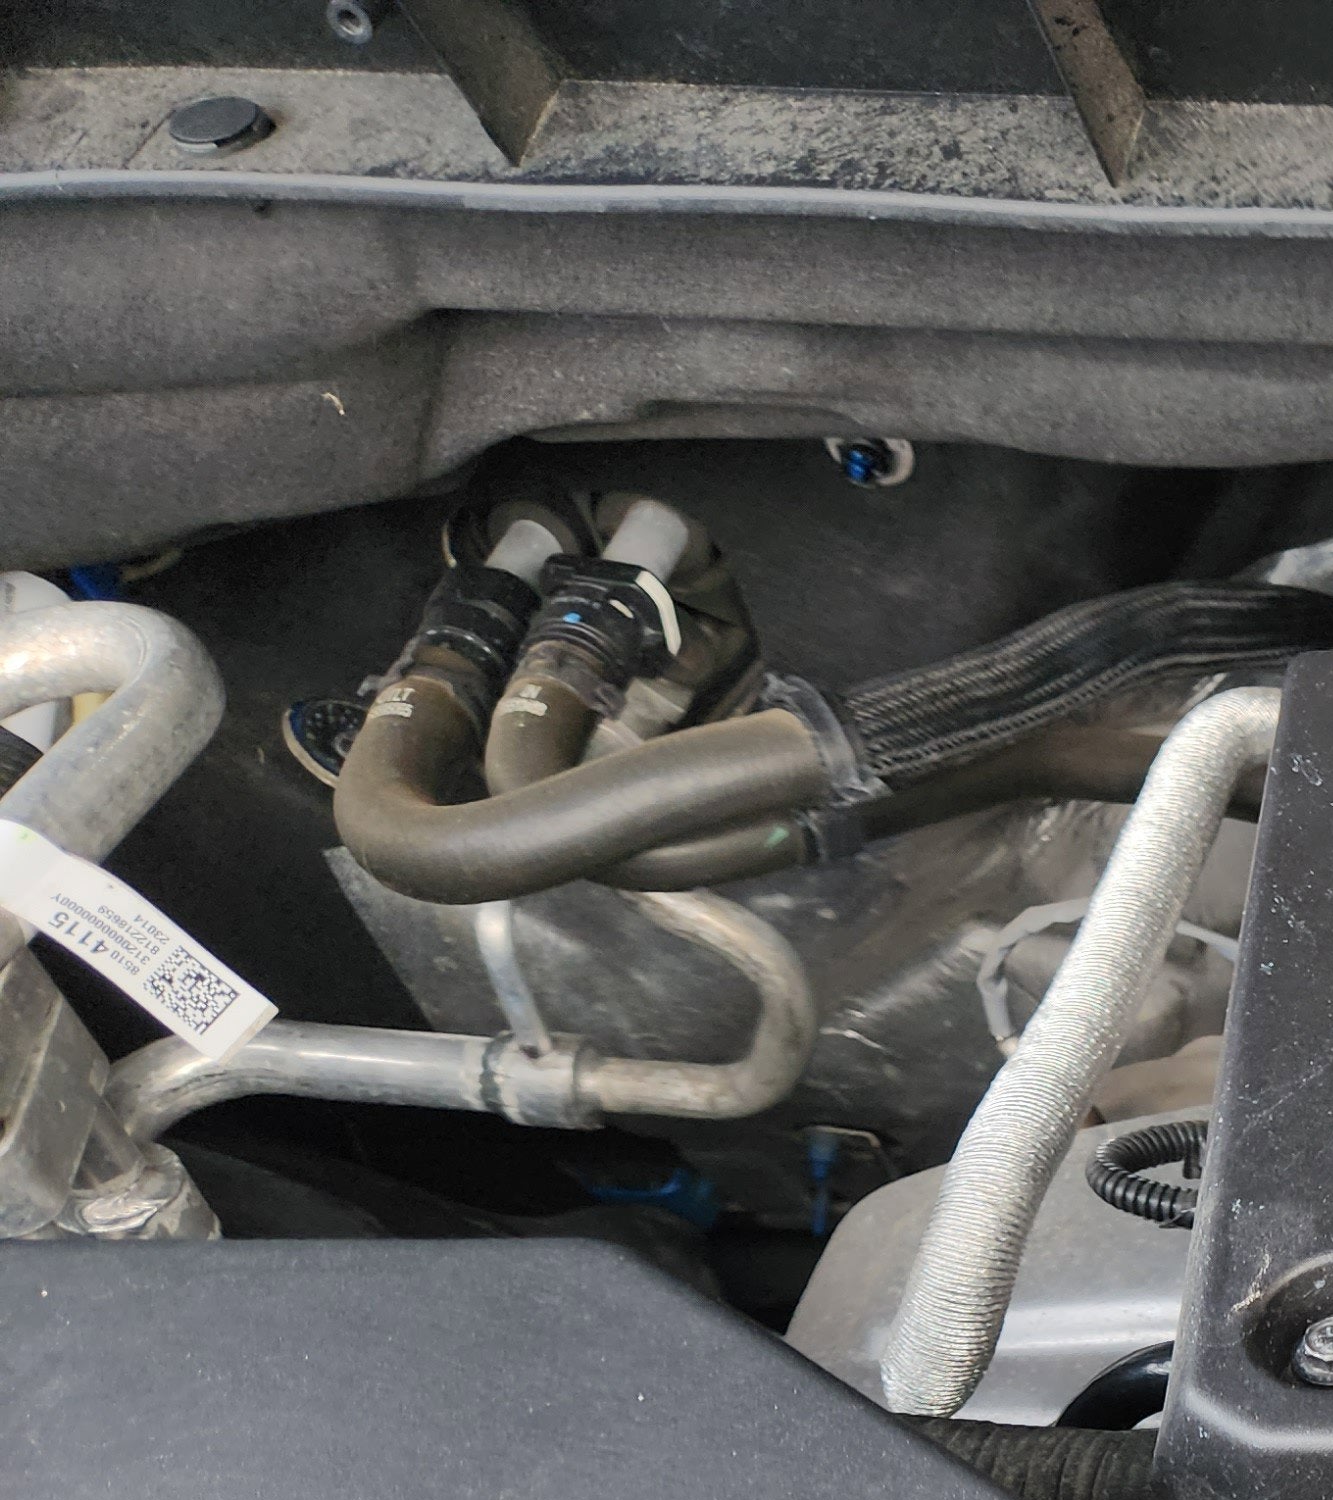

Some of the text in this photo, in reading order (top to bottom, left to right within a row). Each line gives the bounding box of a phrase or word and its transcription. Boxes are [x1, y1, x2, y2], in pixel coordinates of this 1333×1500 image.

[48, 911, 141, 976] 8510 4115
[132, 913, 170, 945] 23014
